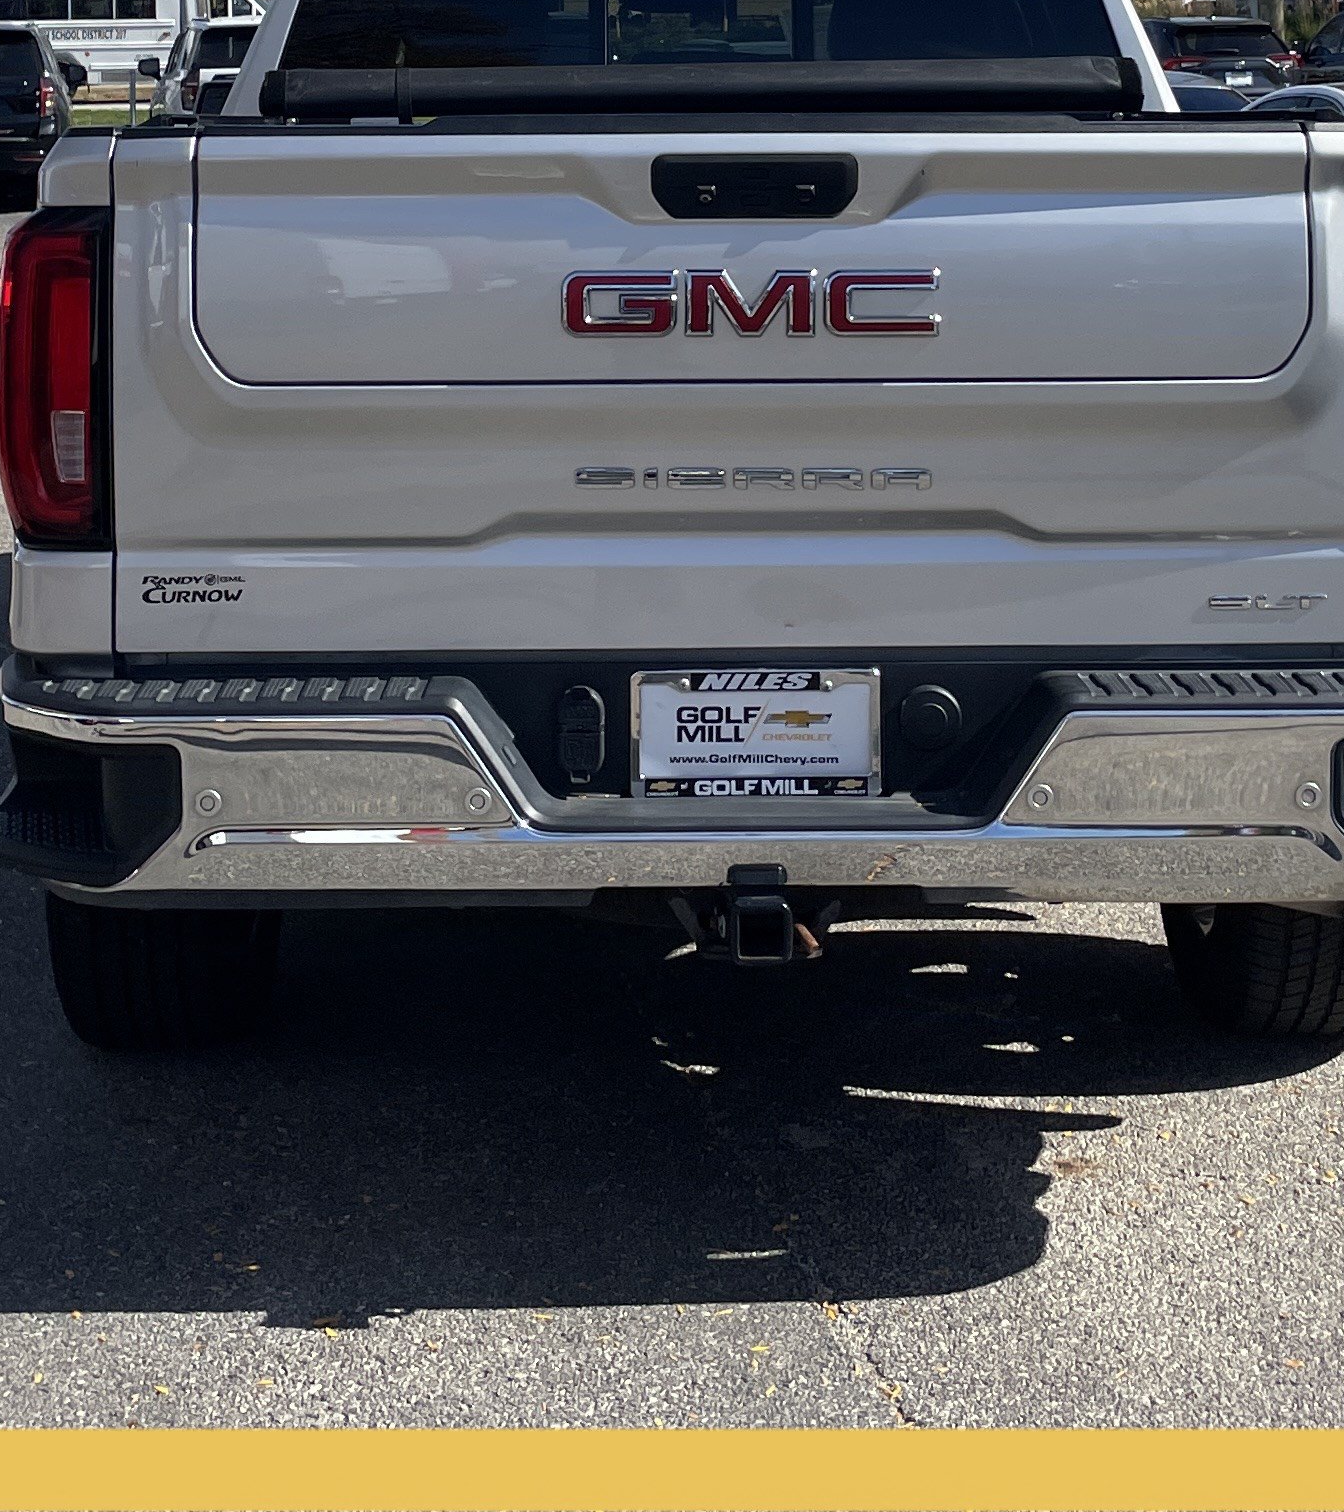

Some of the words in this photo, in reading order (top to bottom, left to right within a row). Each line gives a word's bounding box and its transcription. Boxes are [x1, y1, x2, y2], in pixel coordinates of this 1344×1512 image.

[561, 268, 941, 338] GMC
[574, 467, 933, 490] SIERRA
[141, 575, 204, 587] RANDY
[141, 586, 244, 604] CURNOW
[1208, 592, 1328, 610] SLT
[698, 672, 813, 691] NILES
[676, 706, 762, 724] GOLF
[676, 725, 746, 743] MILL
[669, 754, 840, 766] www.GolfMillChevy.com
[694, 779, 758, 796] GOLF
[761, 779, 819, 796] MILL
